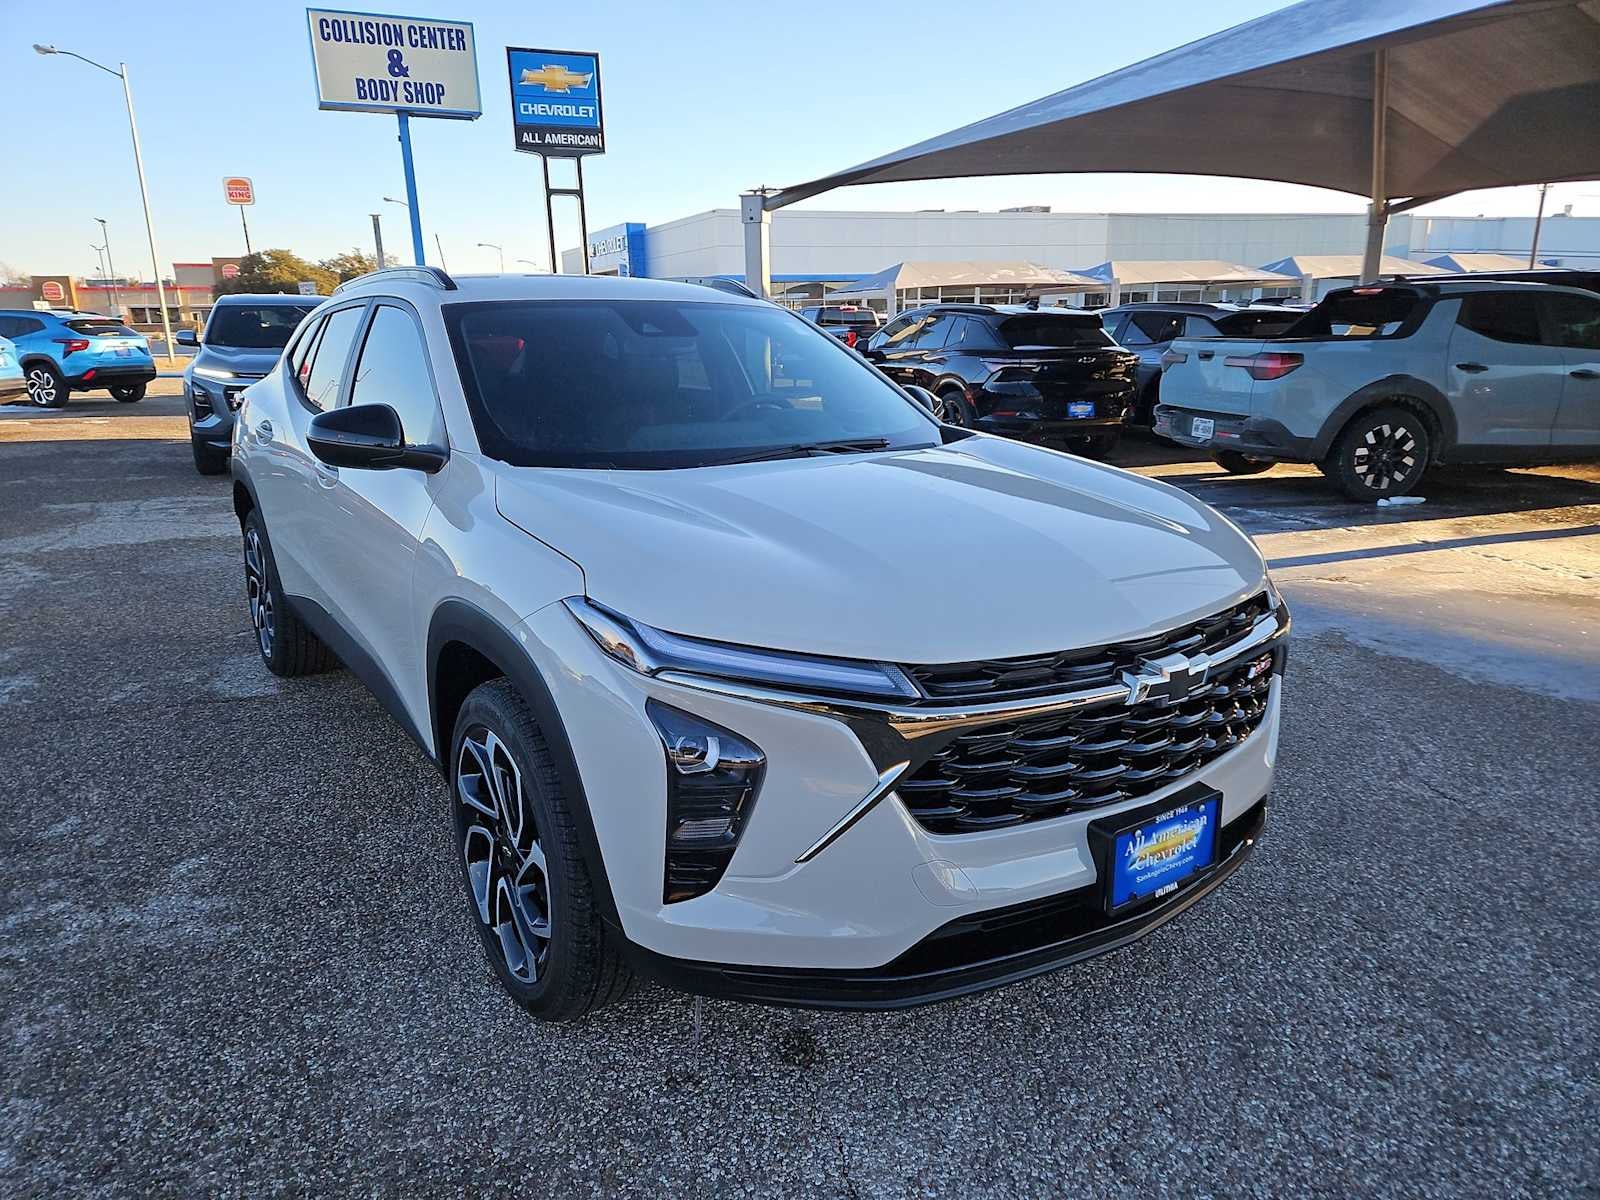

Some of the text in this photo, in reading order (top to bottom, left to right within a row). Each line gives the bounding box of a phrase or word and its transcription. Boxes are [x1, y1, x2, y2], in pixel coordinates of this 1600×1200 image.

[319, 18, 467, 51] COLLISION CENTER
[387, 49, 410, 78] &
[355, 77, 446, 105] BODY SHOP
[519, 102, 595, 118] CHEVROLET
[522, 132, 598, 146] ALL AMERICAN
[1155, 810, 1174, 824] SINCE
[1124, 815, 1208, 857] All American
[1134, 836, 1199, 871] Chevrolet
